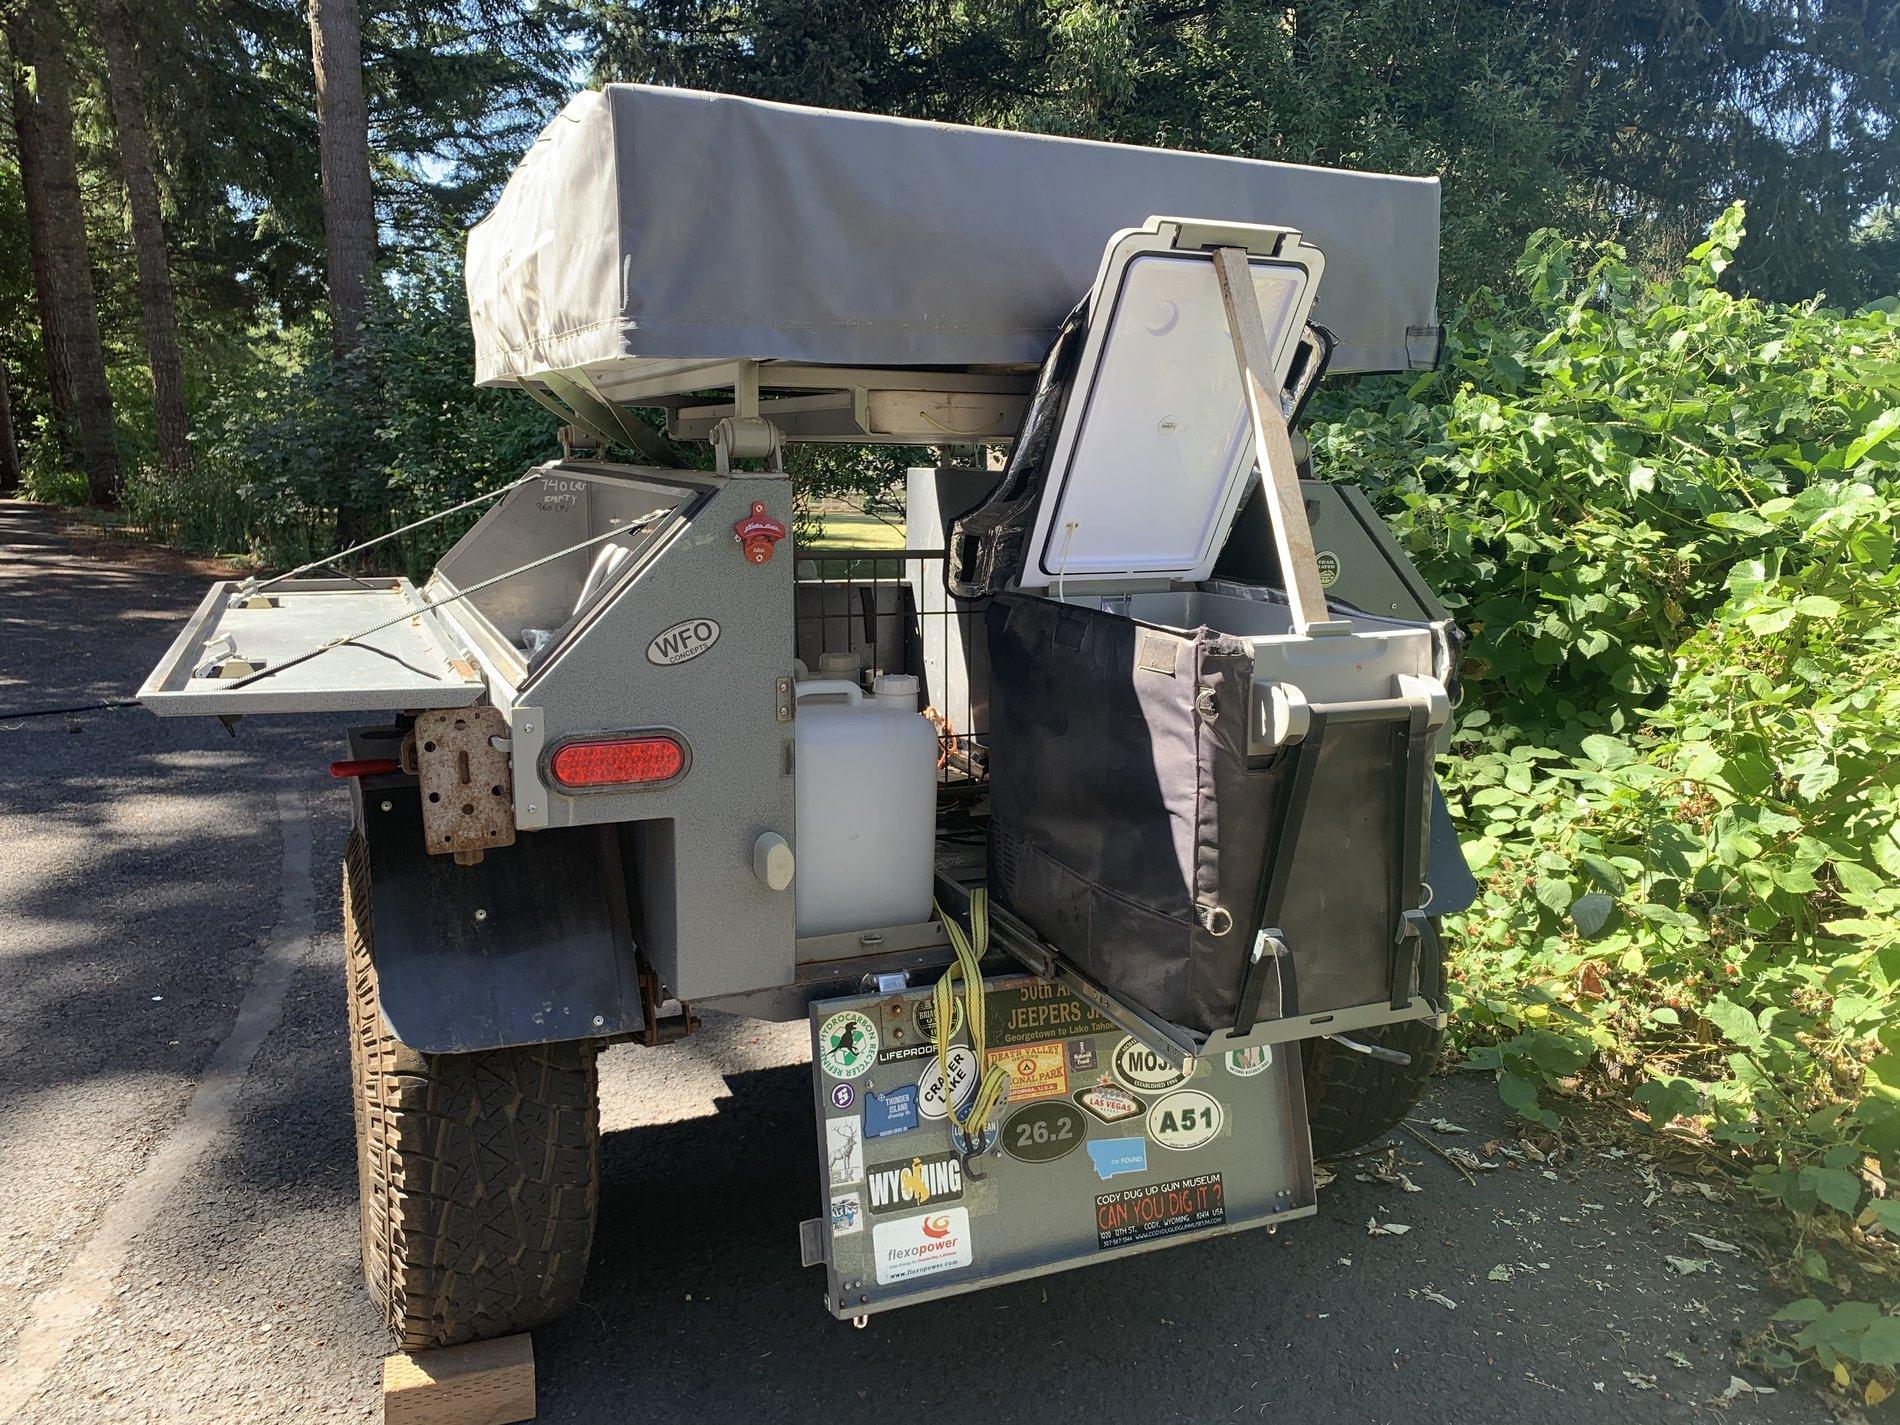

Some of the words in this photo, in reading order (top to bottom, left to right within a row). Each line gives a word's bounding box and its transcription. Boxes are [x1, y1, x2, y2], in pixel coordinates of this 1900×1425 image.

[541, 479, 568, 491] 740
[544, 494, 577, 506] EMPTY
[654, 622, 712, 658] WFO
[669, 642, 708, 663] CONCEPTS
[1008, 1001, 1081, 1030] JEEPERS
[820, 1013, 876, 1041] HYDROCARBON
[1005, 1030, 1056, 1043] Georgetown
[1058, 1028, 1067, 1036] to
[1069, 1024, 1089, 1034] Lake
[1091, 1021, 1115, 1032] Tahoe
[846, 1043, 877, 1076] RECYCLER
[991, 1050, 1022, 1063] DEATH
[1025, 1045, 1060, 1058] VALLEY
[1039, 1066, 1064, 1080] PARK
[1134, 1079, 1166, 1090] ESTABLISHED
[886, 1094, 910, 1106] THUNDER
[889, 1103, 908, 1114] ISLAND
[1090, 1098, 1104, 1107] LAS
[1106, 1101, 1132, 1112] VEGAS
[1159, 1107, 1212, 1134] A51
[1016, 1117, 1069, 1147] 26.2
[1121, 1156, 1143, 1164] FOUND
[1096, 1193, 1121, 1205] CODY
[1123, 1188, 1143, 1200] DUG
[1145, 1186, 1159, 1196] UP
[1161, 1182, 1180, 1192] GUN
[1182, 1173, 1220, 1188] MUSEUM
[1099, 1203, 1128, 1229] CAN
[1132, 1194, 1164, 1223] YOU
[1169, 1190, 1193, 1216] DIG
[1196, 1186, 1208, 1211] IT
[1213, 1183, 1221, 1208] ?
[1163, 1214, 1190, 1226] WYOMING
[1212, 1207, 1224, 1217] USA
[888, 1238, 958, 1261] flexopower
[890, 1260, 958, 1279] www.flexopower.com
